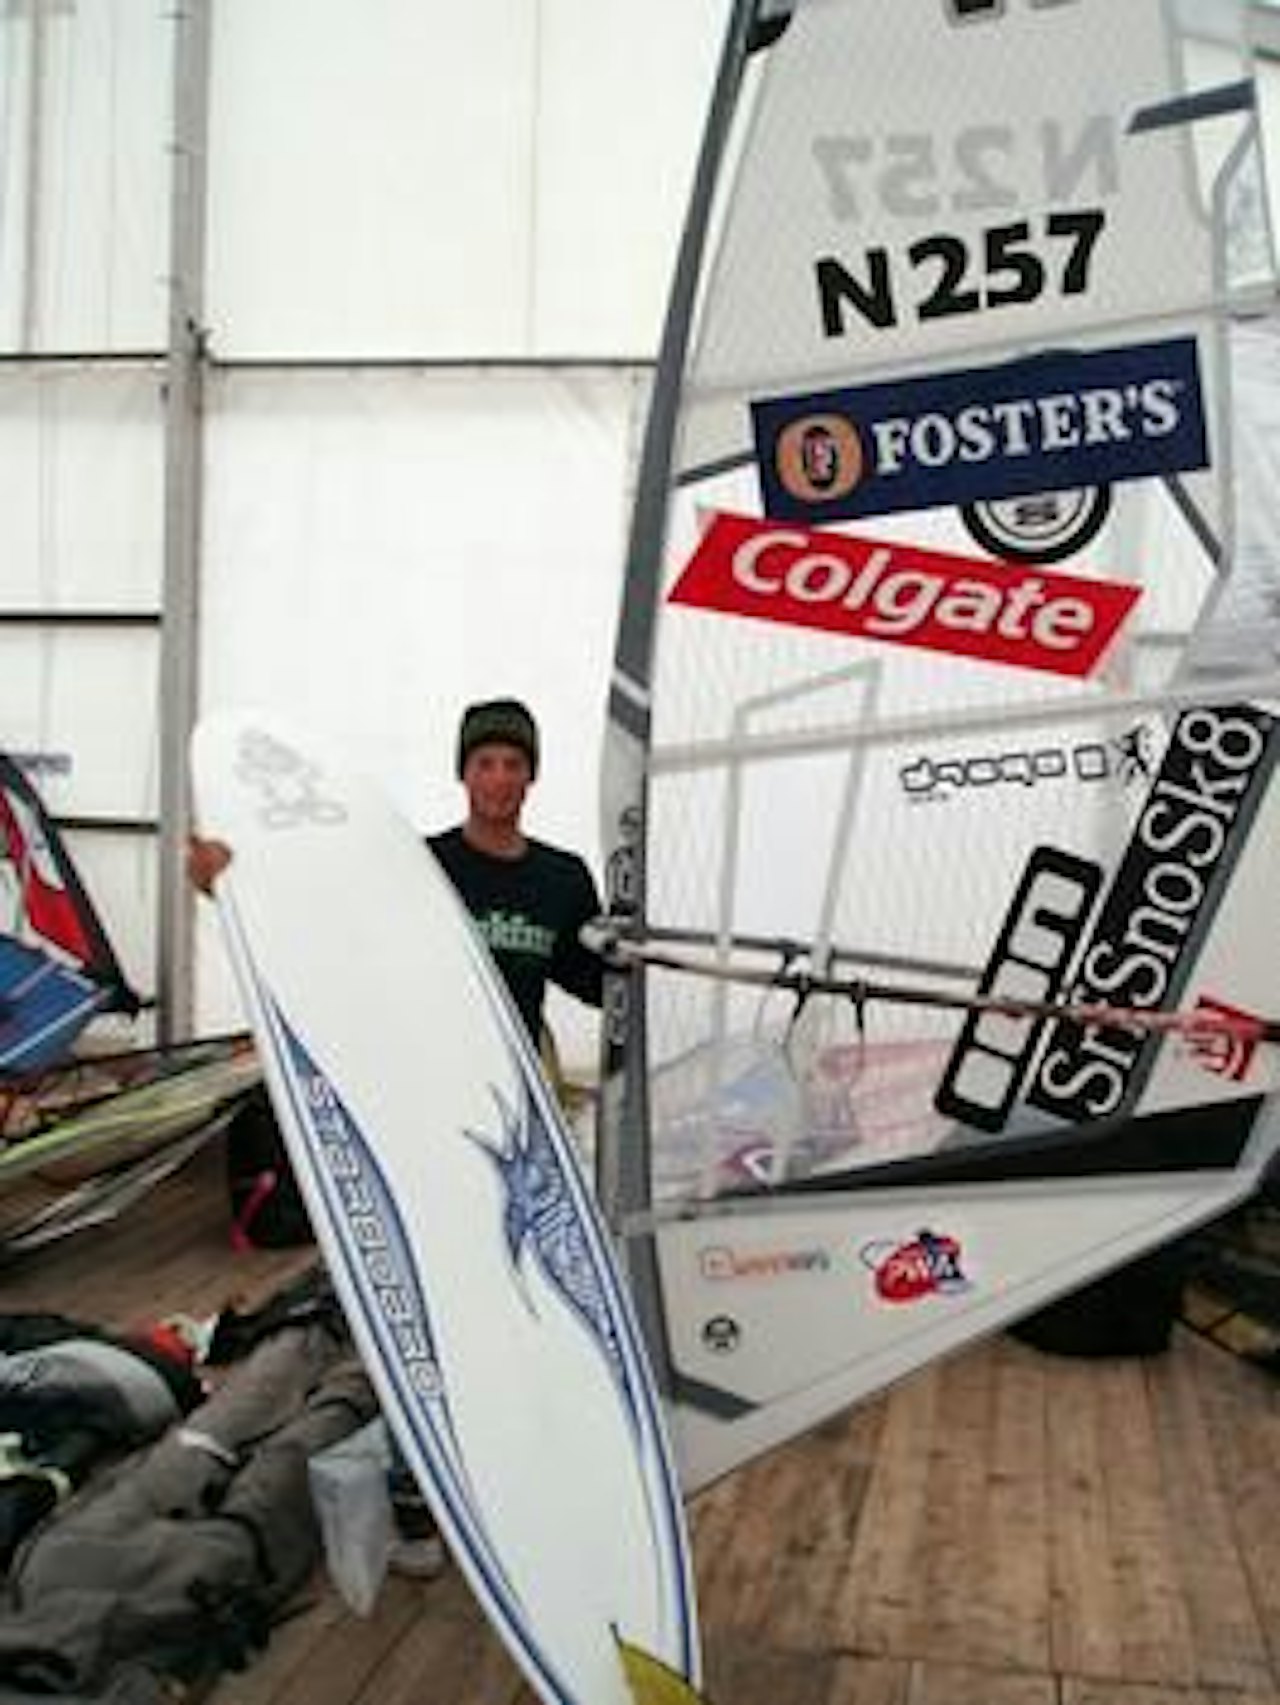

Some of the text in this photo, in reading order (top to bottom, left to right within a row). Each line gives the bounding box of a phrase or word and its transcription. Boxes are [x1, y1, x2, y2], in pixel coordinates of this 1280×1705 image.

[815, 209, 1105, 337] N257
[872, 380, 1178, 475] FOSTER'S
[730, 530, 1095, 649] Colgate
